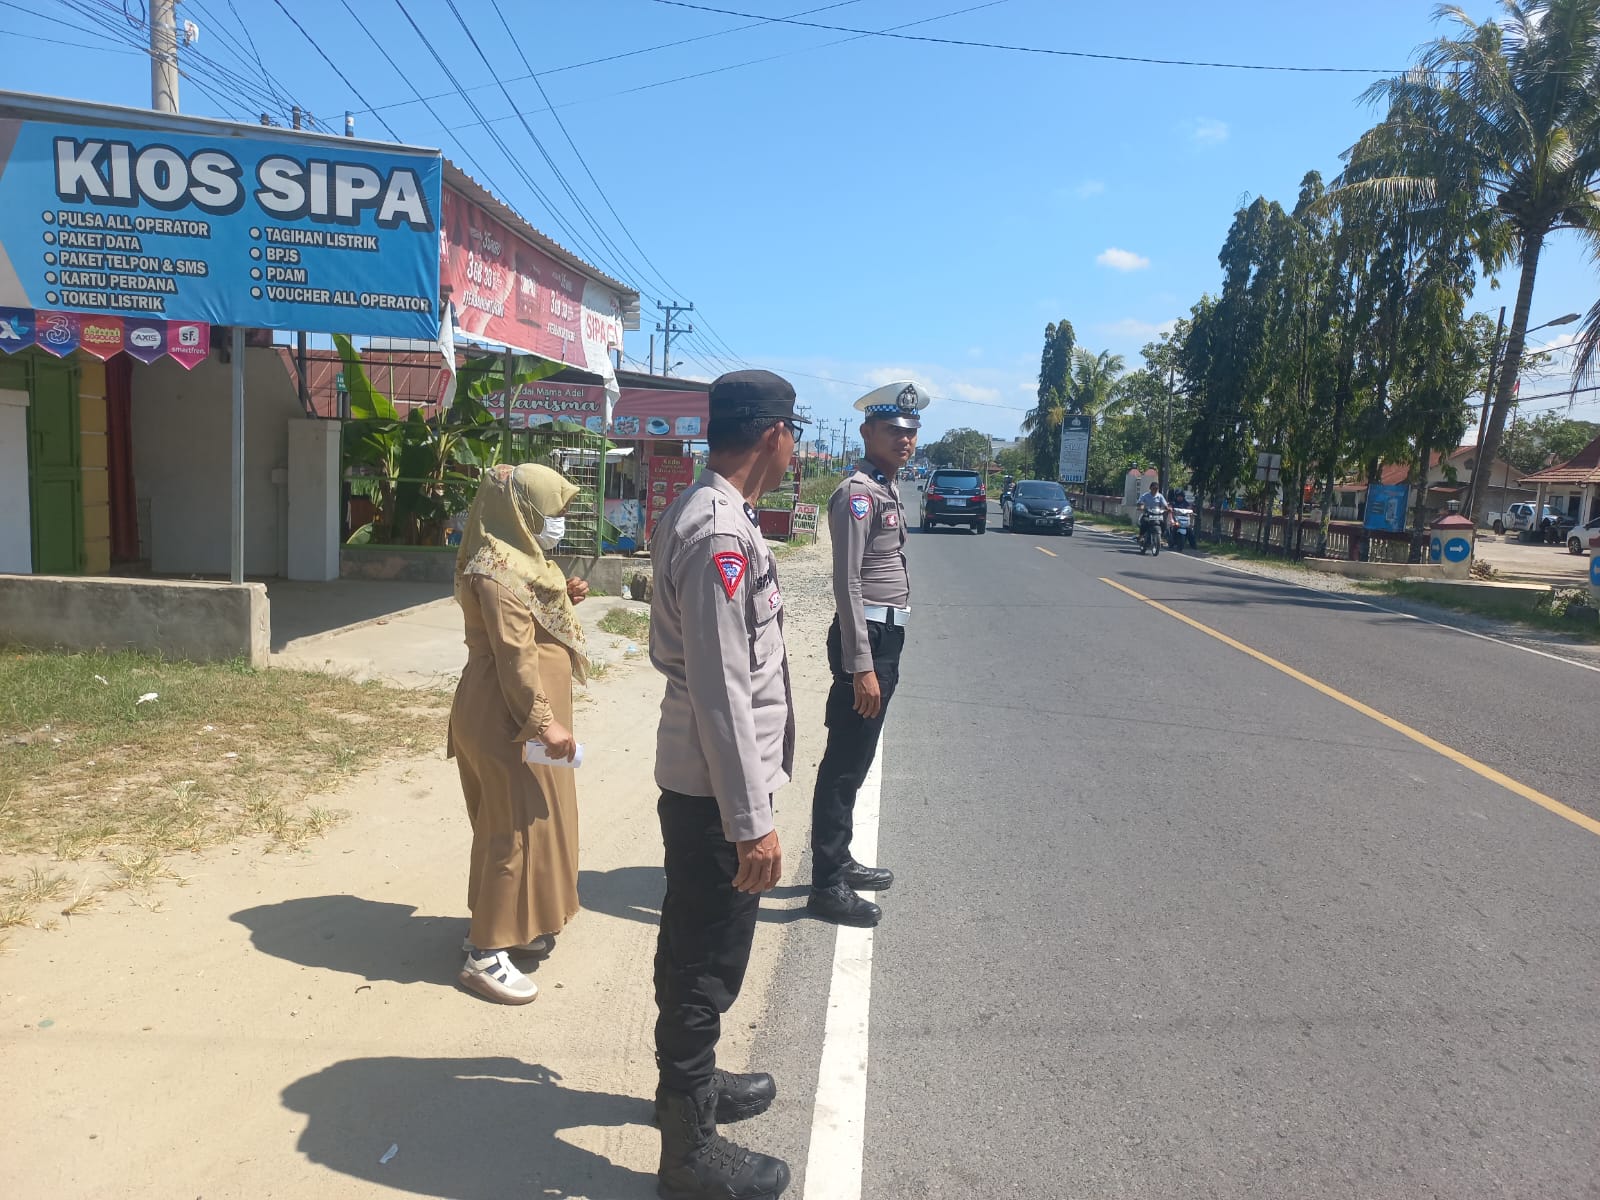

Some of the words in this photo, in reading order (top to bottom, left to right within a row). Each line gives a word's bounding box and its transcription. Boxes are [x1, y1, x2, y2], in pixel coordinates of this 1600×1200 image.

[55, 138, 242, 213] KIOS
[256, 155, 431, 229] SIPA
[58, 211, 103, 228] PULSA
[107, 215, 133, 230] ALL
[136, 217, 210, 237] OPERATOR
[59, 231, 103, 248] PAKET
[106, 235, 140, 251] DATA
[265, 227, 323, 246] TAGIHAN
[326, 233, 377, 250] LISTRIK
[60, 251, 103, 267] PAKET
[107, 254, 160, 273] TELPON
[162, 258, 174, 272] &
[176, 260, 206, 276] SMS
[266, 247, 299, 263] BPJS
[61, 271, 106, 288] KARTU
[110, 274, 176, 292] PERDANA
[267, 267, 305, 283] PDAM
[61, 290, 107, 307] TOKEN
[111, 293, 163, 311] LISTRIK
[267, 286, 330, 304] VOUCHER
[333, 291, 357, 306] ALL
[360, 293, 430, 313] OPERATOR
[135, 333, 158, 342] AXIS
[536, 387, 562, 397] Mama
[565, 388, 585, 398] Adel
[795, 513, 817, 521] NASI
